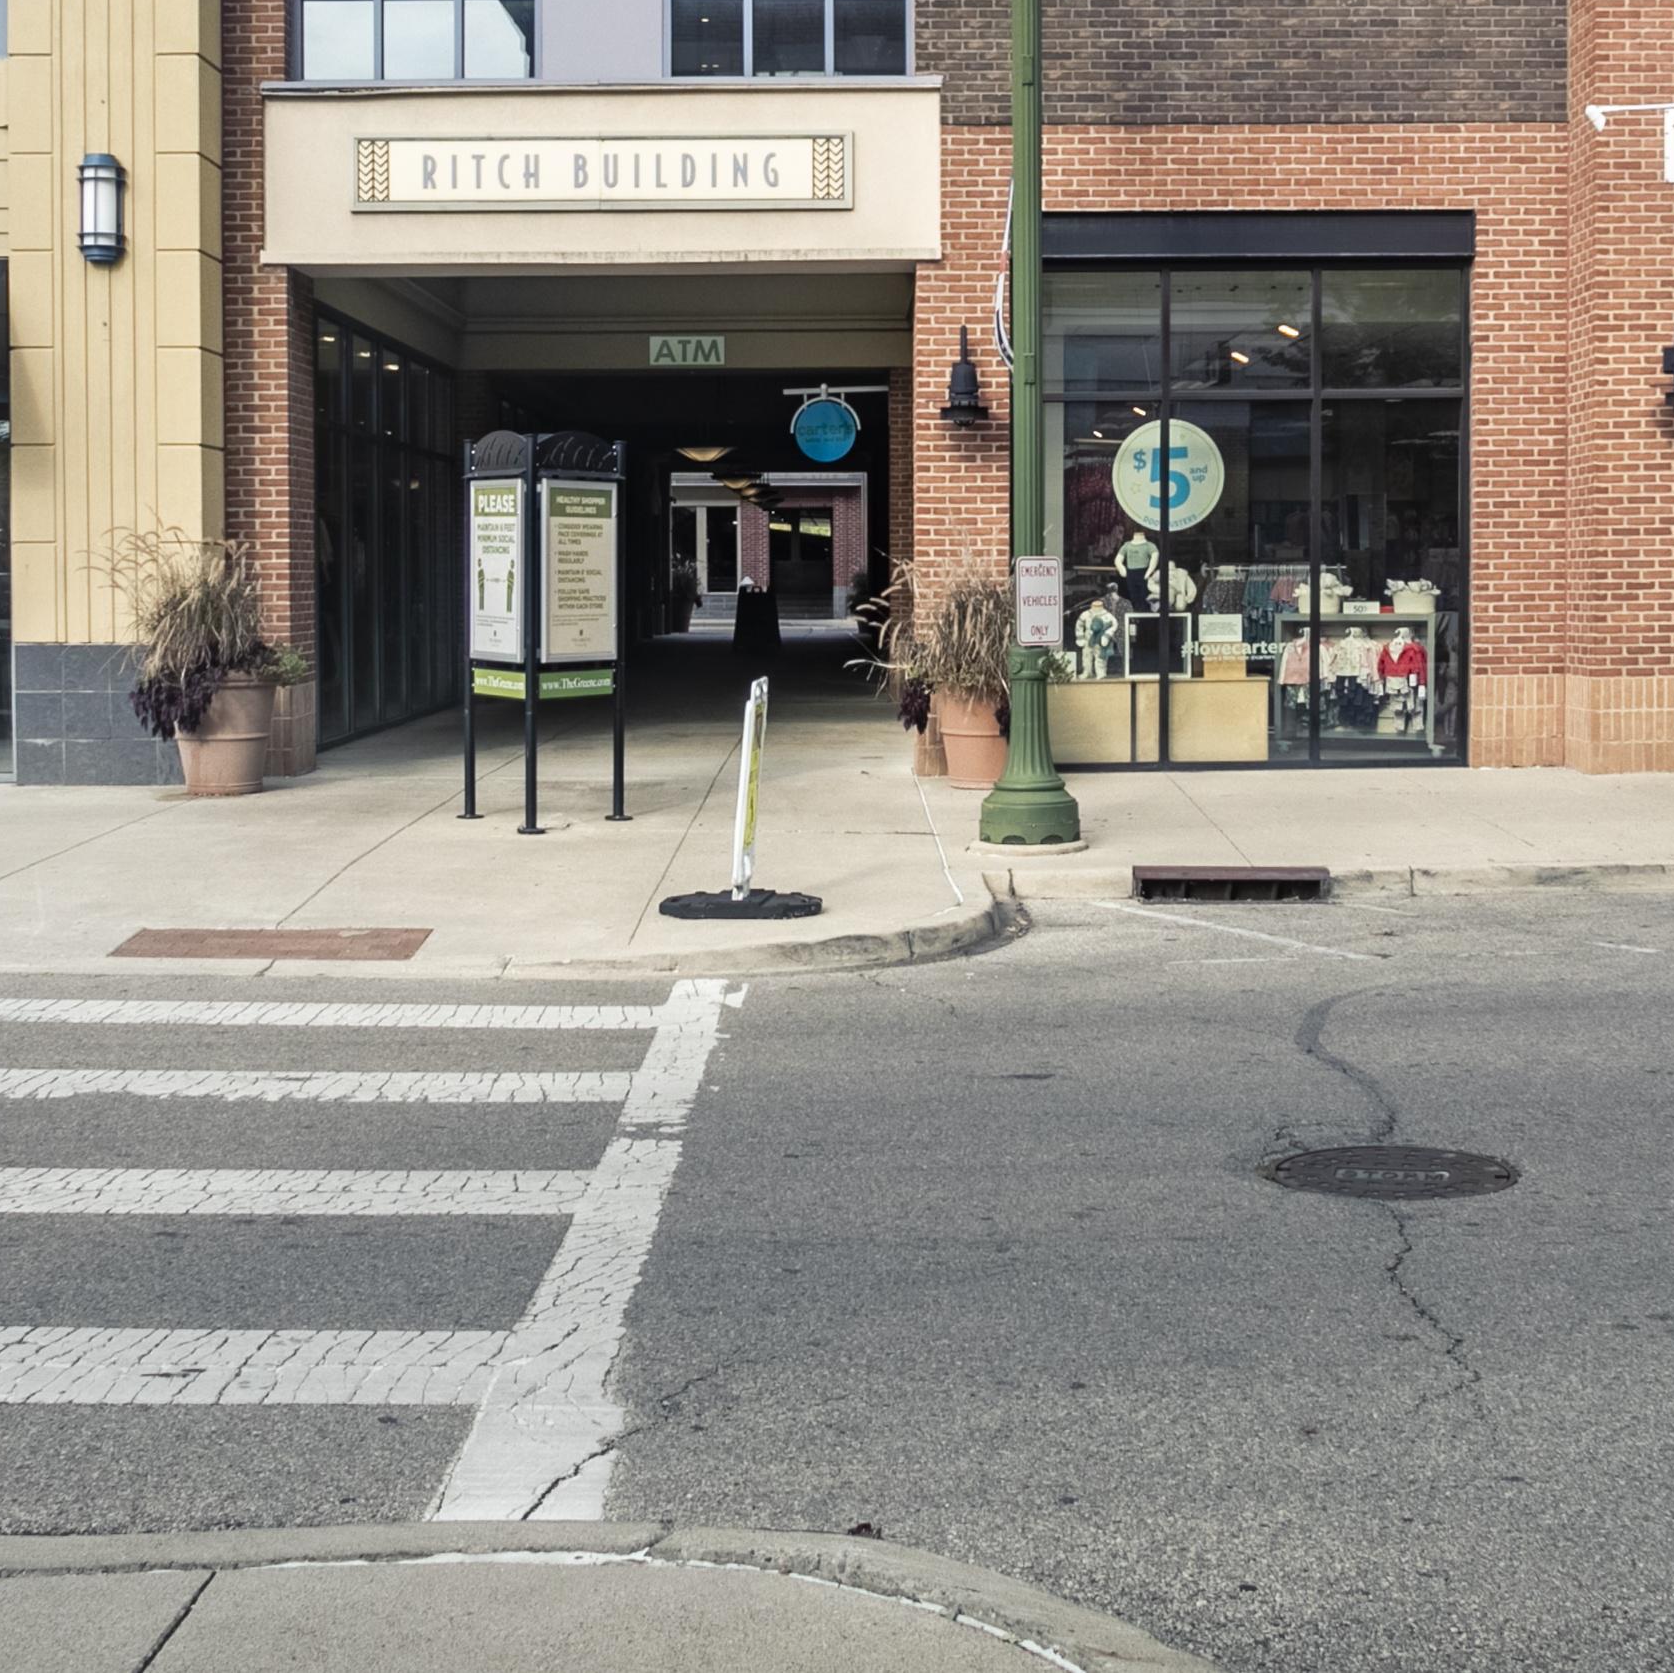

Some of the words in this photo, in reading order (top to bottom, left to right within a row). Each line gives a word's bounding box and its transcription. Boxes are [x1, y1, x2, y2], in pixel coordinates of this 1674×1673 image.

[422, 153, 540, 190] RITCH
[573, 152, 780, 189] BUILDING
[653, 339, 722, 363] ATM
[1189, 464, 1208, 475] and
[1132, 446, 1191, 509] $5
[1191, 475, 1206, 484] up
[478, 494, 515, 513] PLEASE
[1020, 565, 1057, 577] EMERGENCY
[1021, 595, 1058, 607] VEHICLES
[1030, 625, 1049, 636] ONLY
[1180, 640, 1297, 659] #lovecarters
